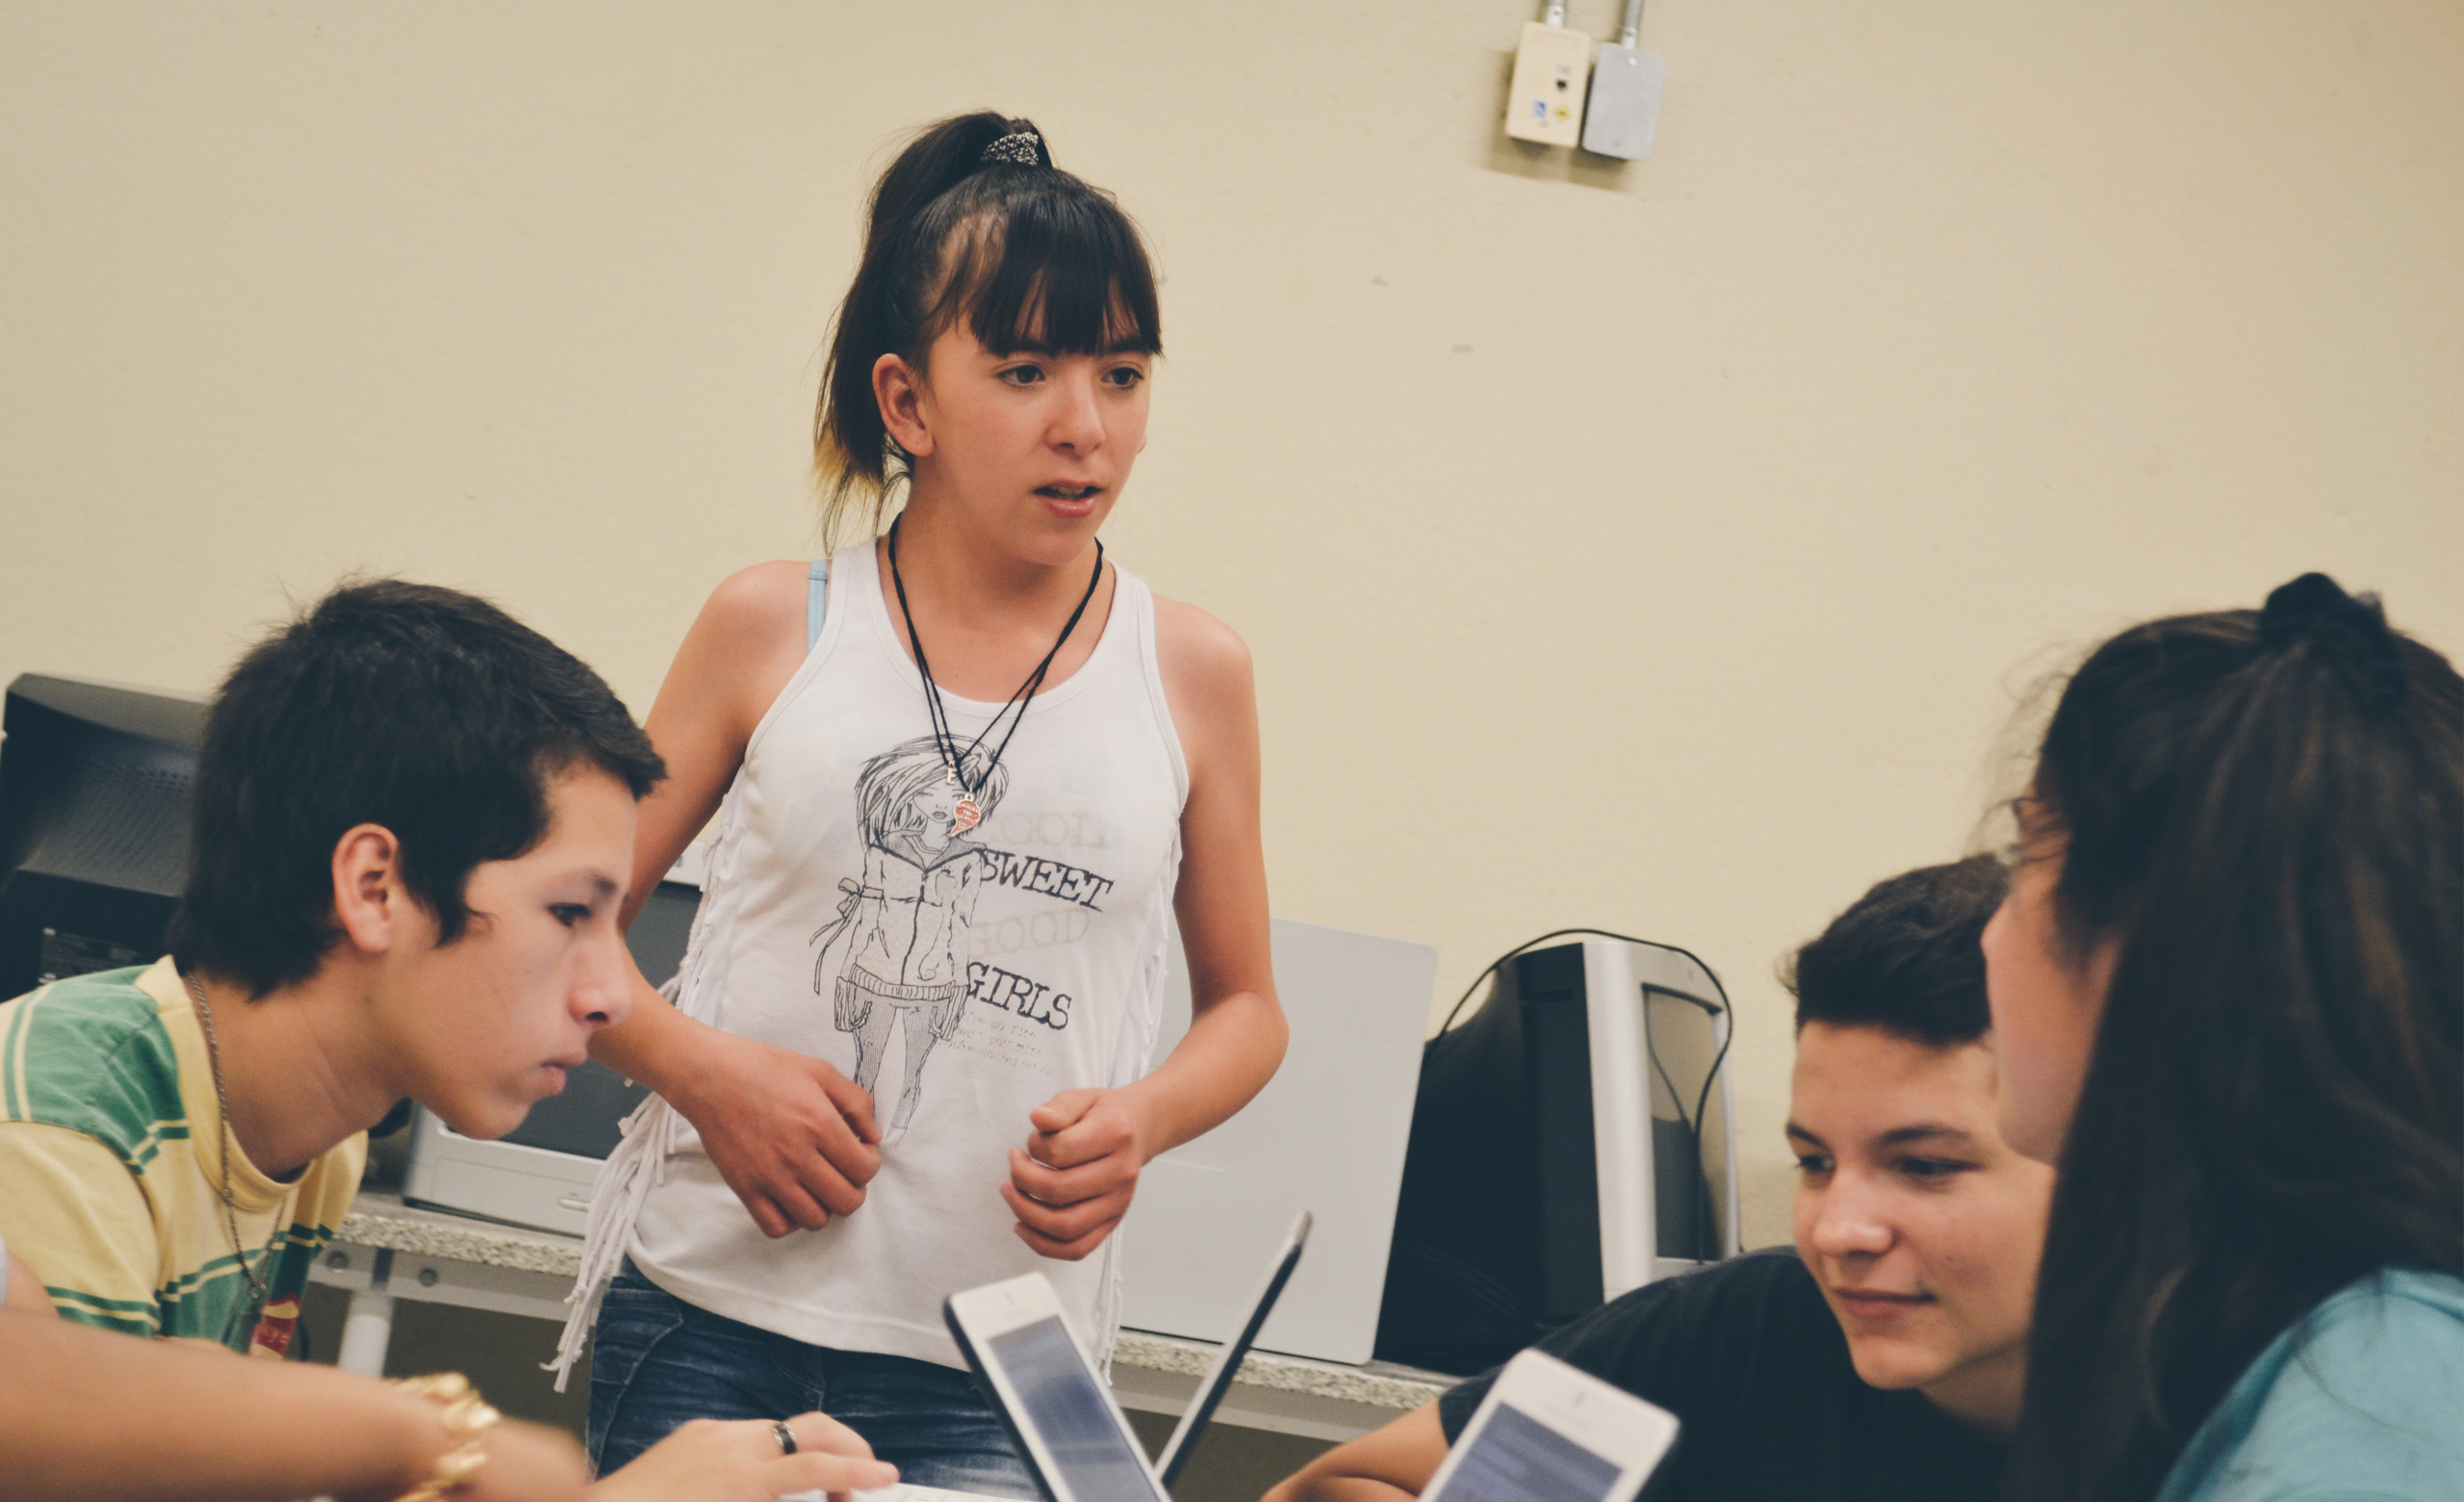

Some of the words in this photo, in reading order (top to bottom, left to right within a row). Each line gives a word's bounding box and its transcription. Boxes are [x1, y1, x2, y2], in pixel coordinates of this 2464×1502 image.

[988, 812, 1111, 850] OOL
[980, 847, 1115, 913] SWEET
[966, 961, 1072, 1031] GIRLS
